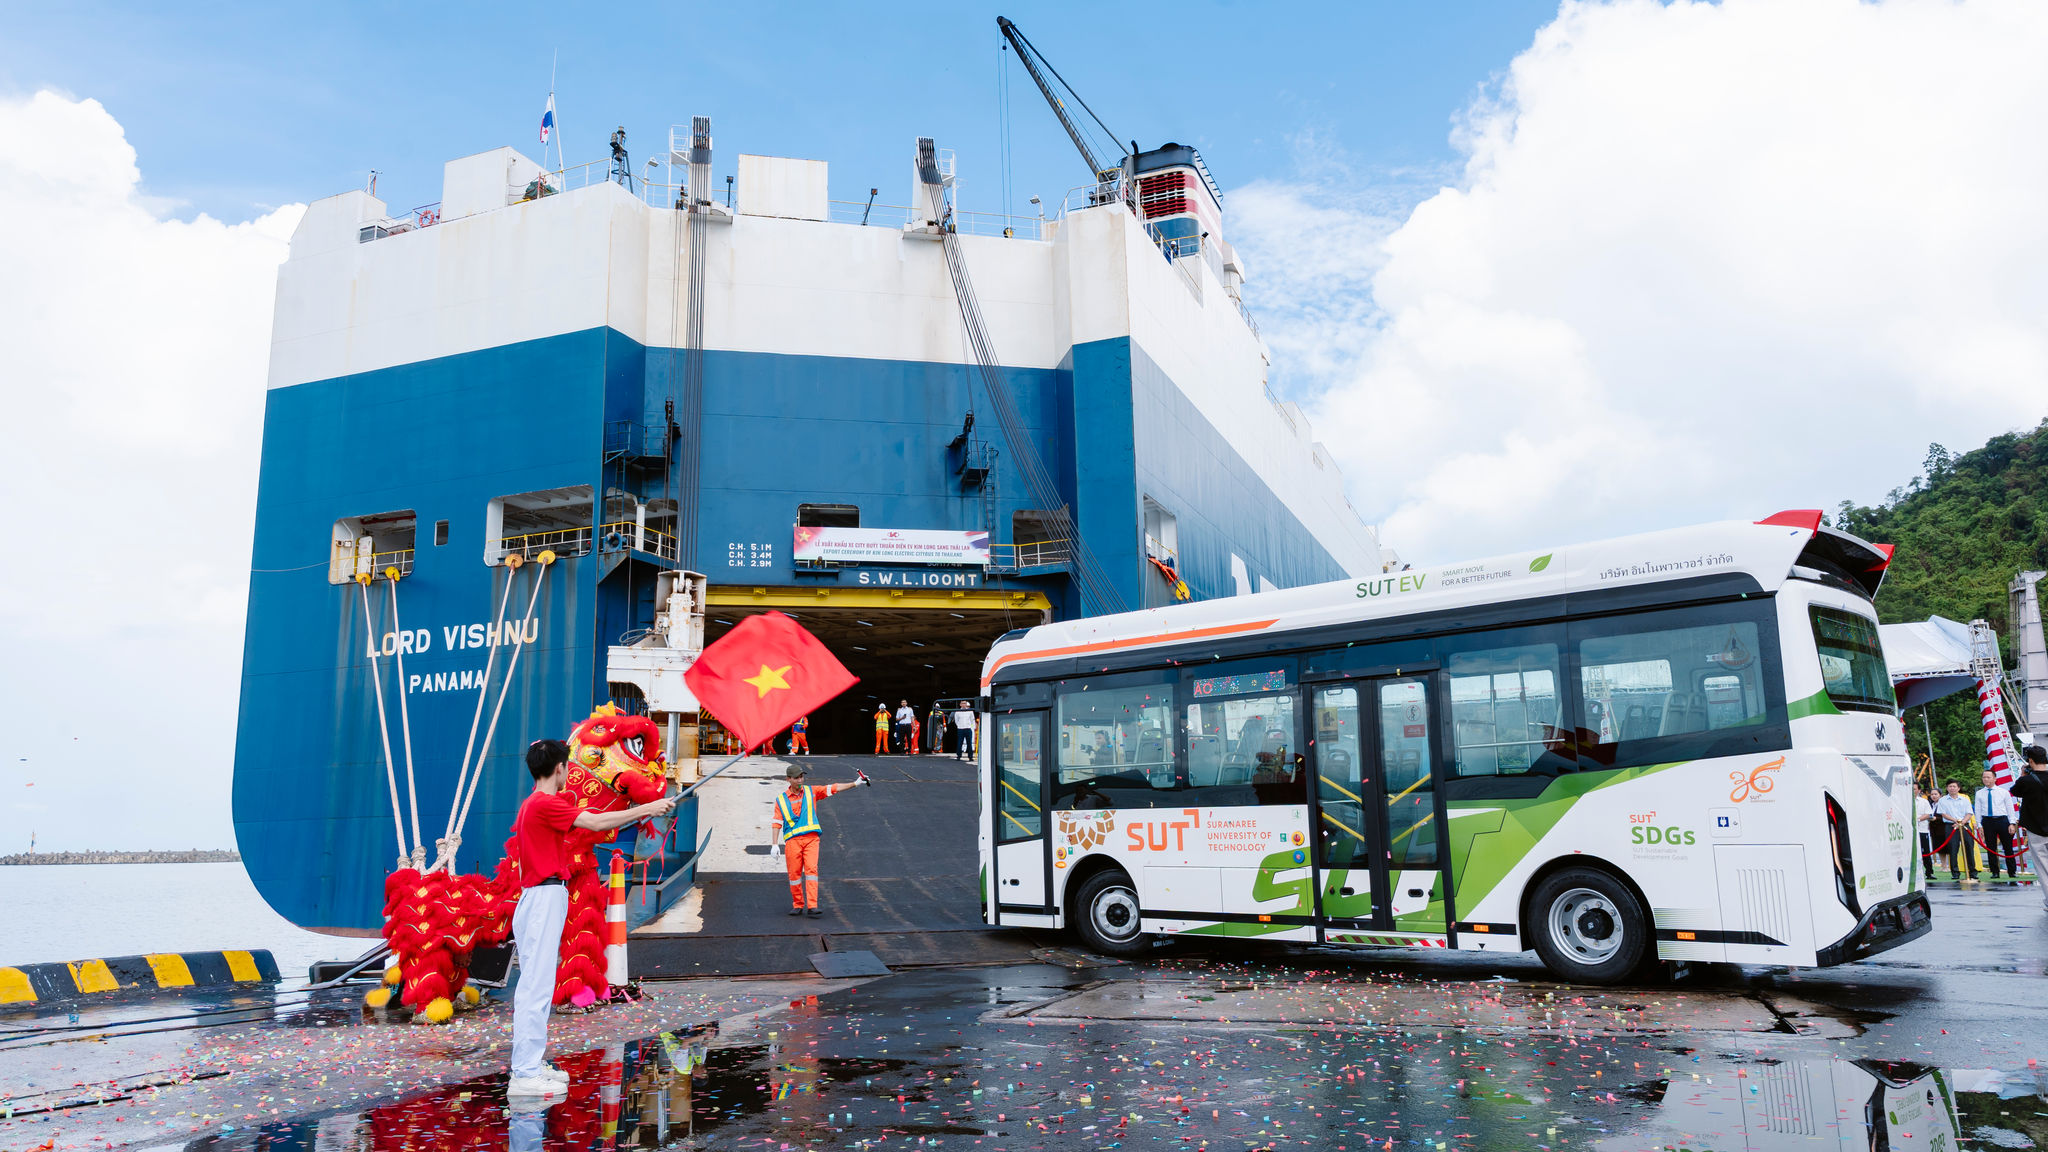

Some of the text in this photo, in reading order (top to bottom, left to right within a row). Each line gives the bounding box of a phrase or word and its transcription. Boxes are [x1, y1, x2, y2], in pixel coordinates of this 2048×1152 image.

[728, 542, 772, 551] C.H. 5.1M
[728, 551, 772, 559] C.H. 3.4M
[728, 559, 772, 568] C.H. 2.9M
[1442, 565, 1484, 577] SMART MOVE
[1441, 579, 1454, 587] FOR
[1461, 574, 1486, 584] BETTER
[1486, 570, 1512, 580] FUTURE
[1356, 573, 1426, 599] SUT EV
[366, 617, 539, 658] LORD VISHNU
[409, 669, 486, 694] PANAMA
[1207, 820, 1257, 829] SURANAREE
[1629, 814, 1653, 823] SUT
[1126, 821, 1190, 851] SUT
[1207, 831, 1272, 840] UNIVERSITY OF
[1631, 826, 1696, 845] SDGs
[1888, 822, 1905, 842] SDGs
[1208, 843, 1266, 852] TECHNOLOGY
